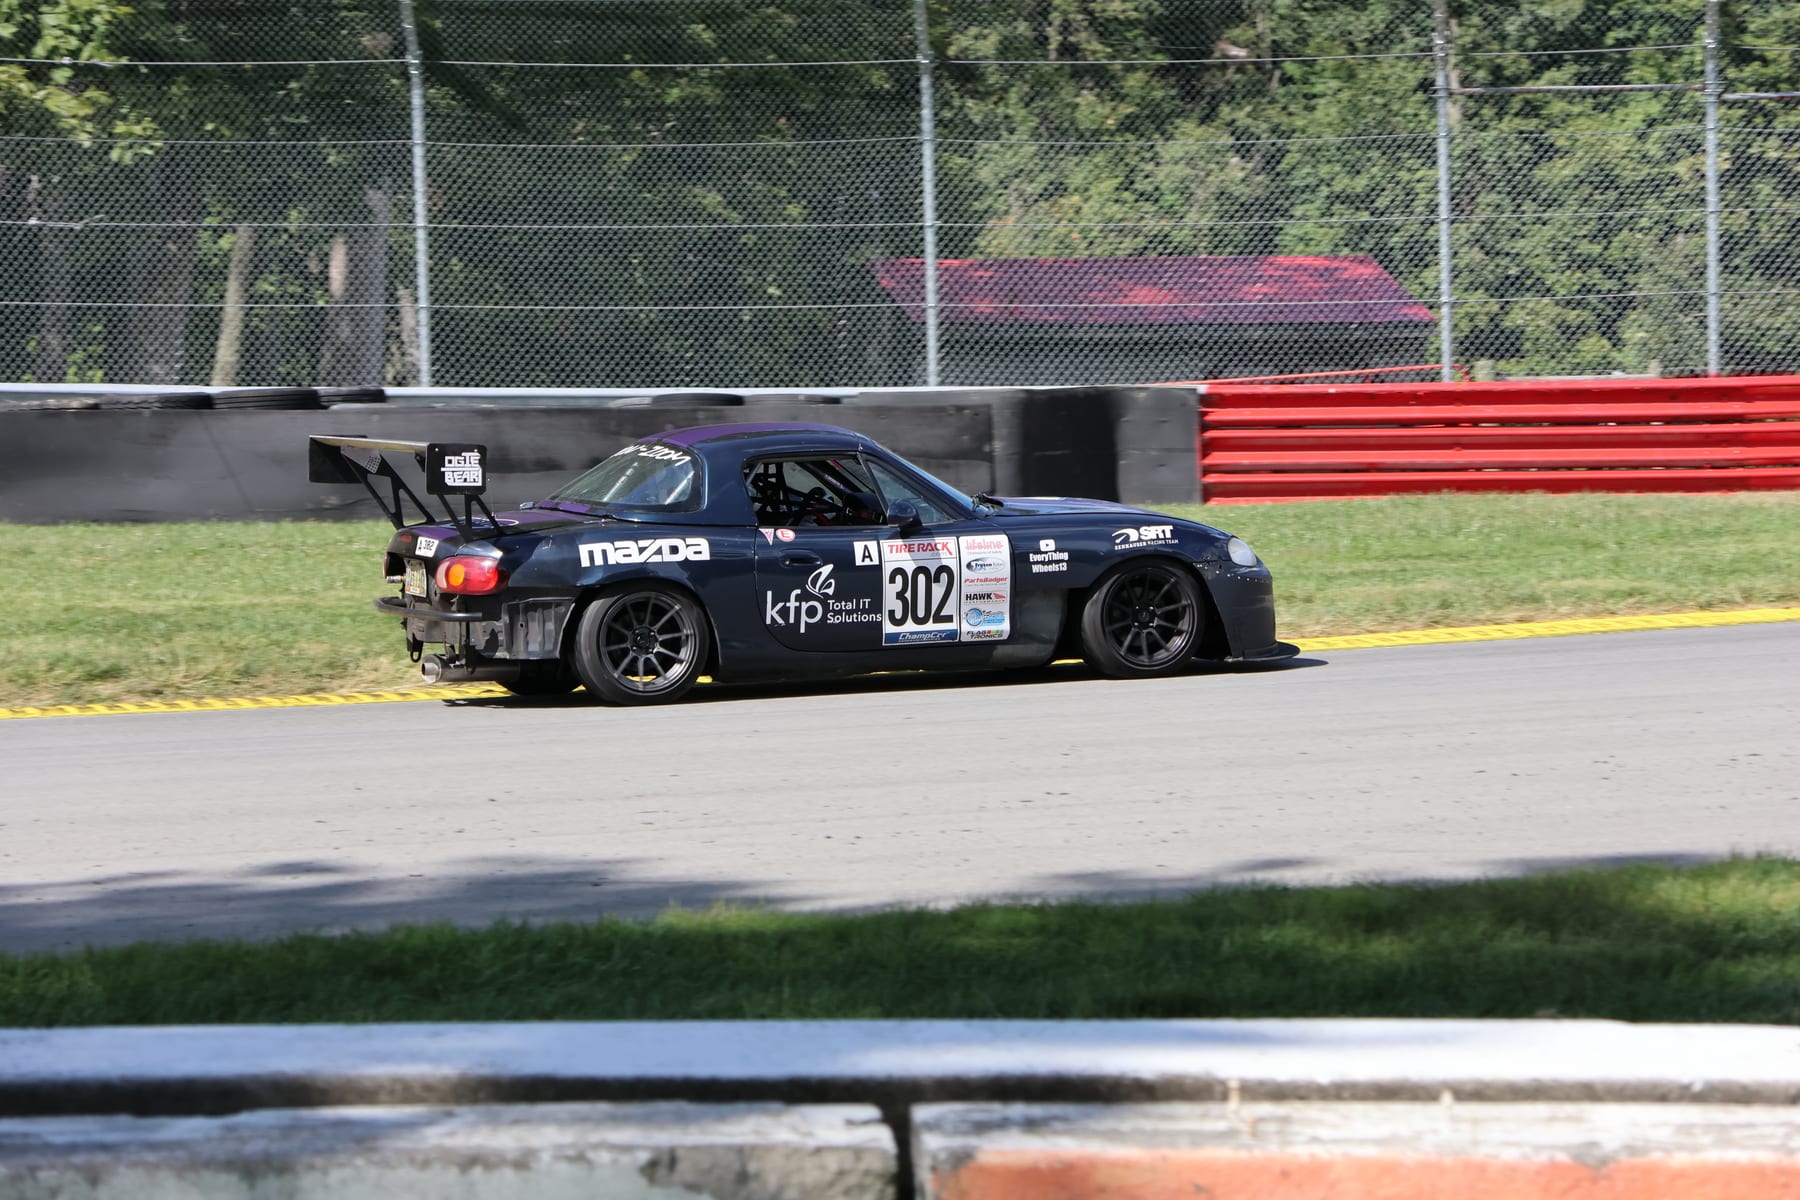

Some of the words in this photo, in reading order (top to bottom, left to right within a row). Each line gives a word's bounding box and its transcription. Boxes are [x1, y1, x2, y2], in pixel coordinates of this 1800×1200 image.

[1139, 525, 1174, 540] SRT
[861, 544, 874, 563] A
[887, 543, 915, 554] TIRE
[917, 541, 953, 556] RACK
[1029, 551, 1069, 562] EveryThing
[1031, 562, 1067, 573] Wheels13
[887, 564, 955, 628] 302
[965, 592, 992, 601] HAWK
[766, 589, 823, 633] kfp
[827, 598, 856, 611] Total
[859, 598, 871, 609] IT
[827, 612, 882, 623] Solutions
